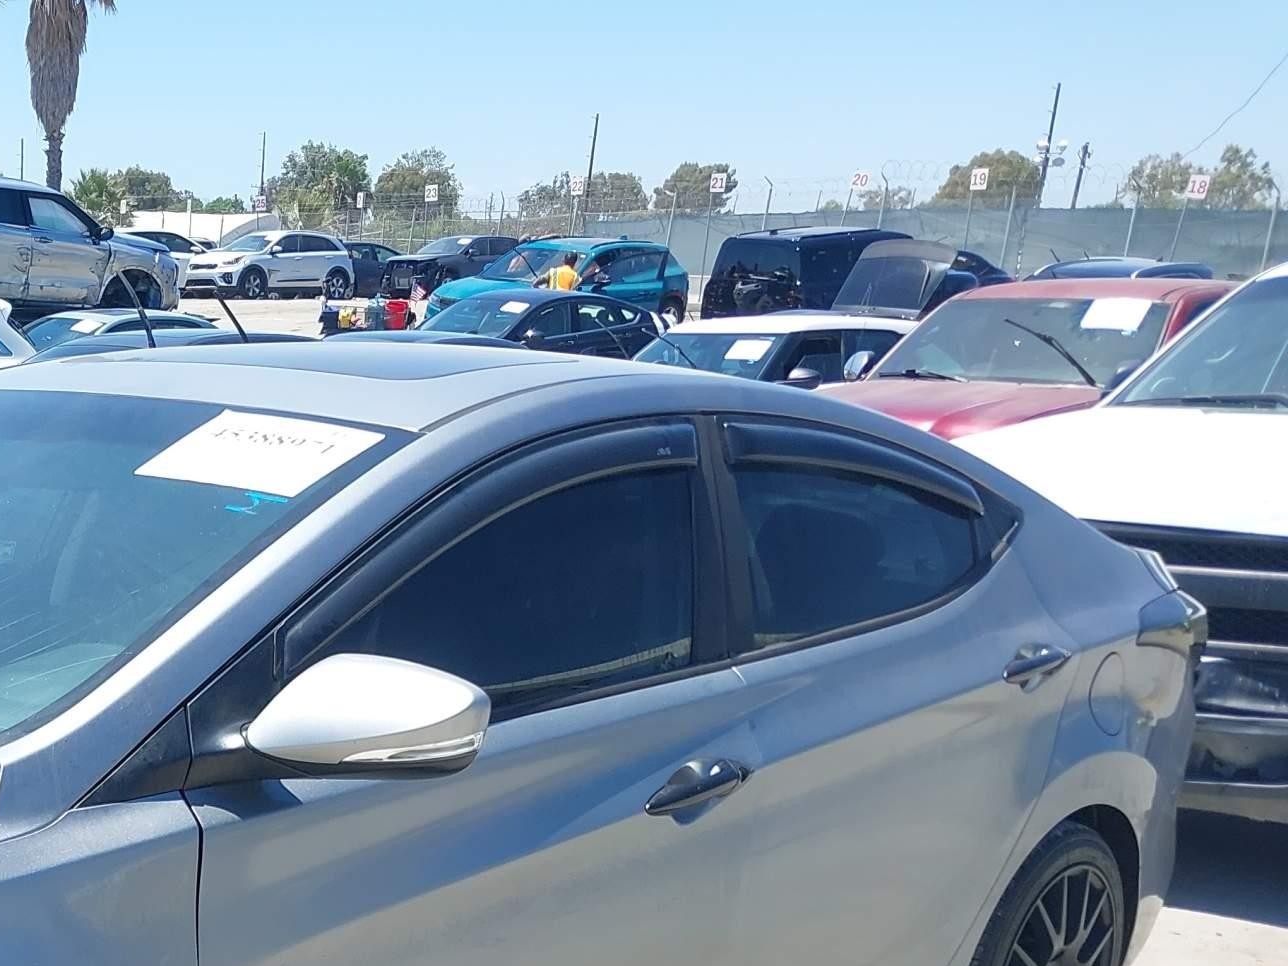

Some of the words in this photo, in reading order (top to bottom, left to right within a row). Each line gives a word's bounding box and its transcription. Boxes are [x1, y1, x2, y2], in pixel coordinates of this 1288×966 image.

[712, 177, 724, 189] 21
[852, 174, 869, 187] 20
[971, 172, 987, 186] 19
[572, 181, 583, 191] 22
[1188, 180, 1207, 194] 18
[426, 188, 437, 199] 23
